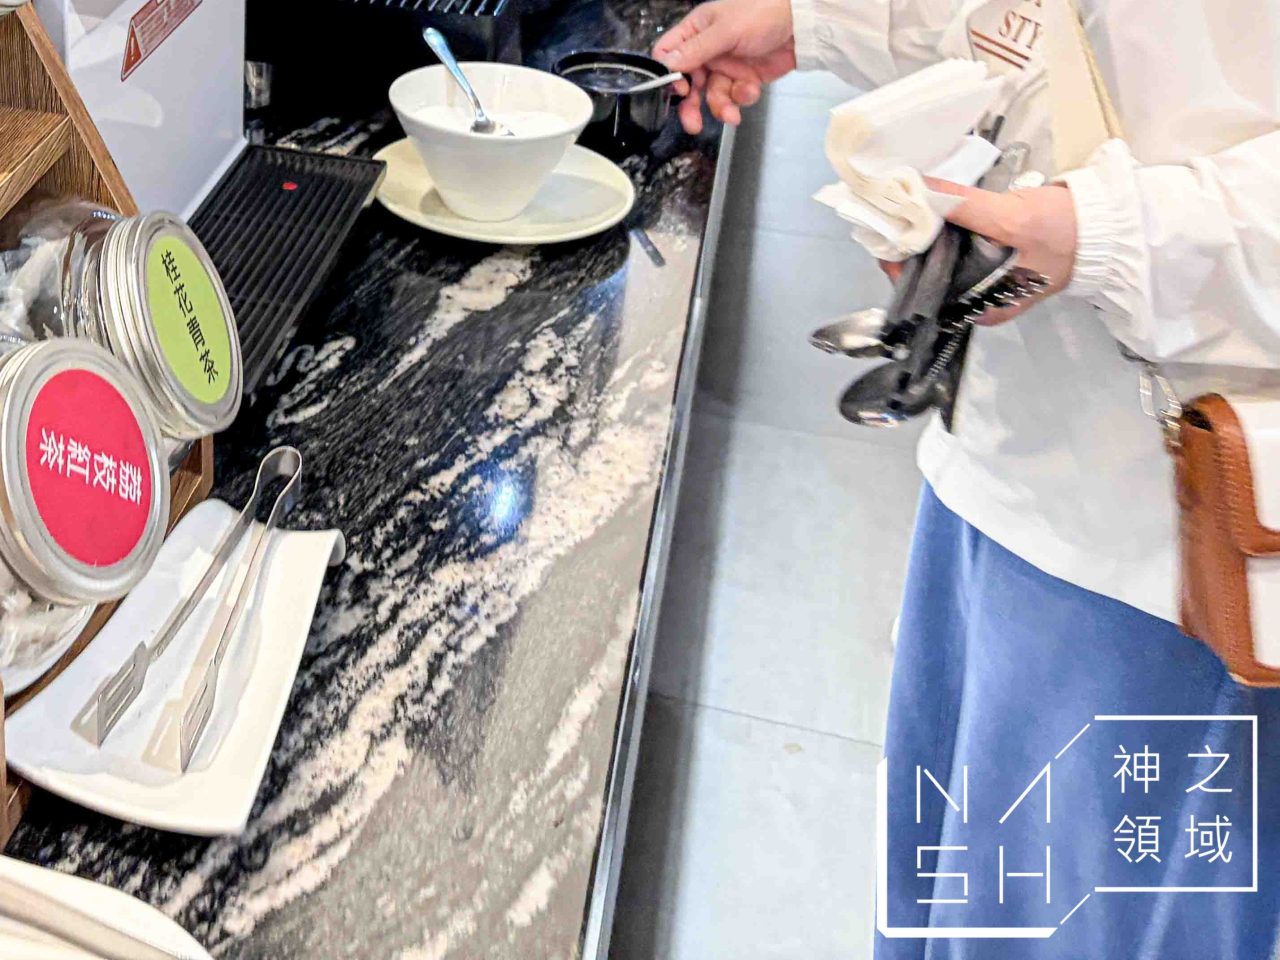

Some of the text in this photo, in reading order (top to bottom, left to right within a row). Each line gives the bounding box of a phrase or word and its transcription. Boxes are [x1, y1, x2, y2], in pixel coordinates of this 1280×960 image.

[998, 9, 1042, 50] STY
[161, 249, 218, 384] 桂花青茶
[39, 427, 143, 506] 荔枝紅茶
